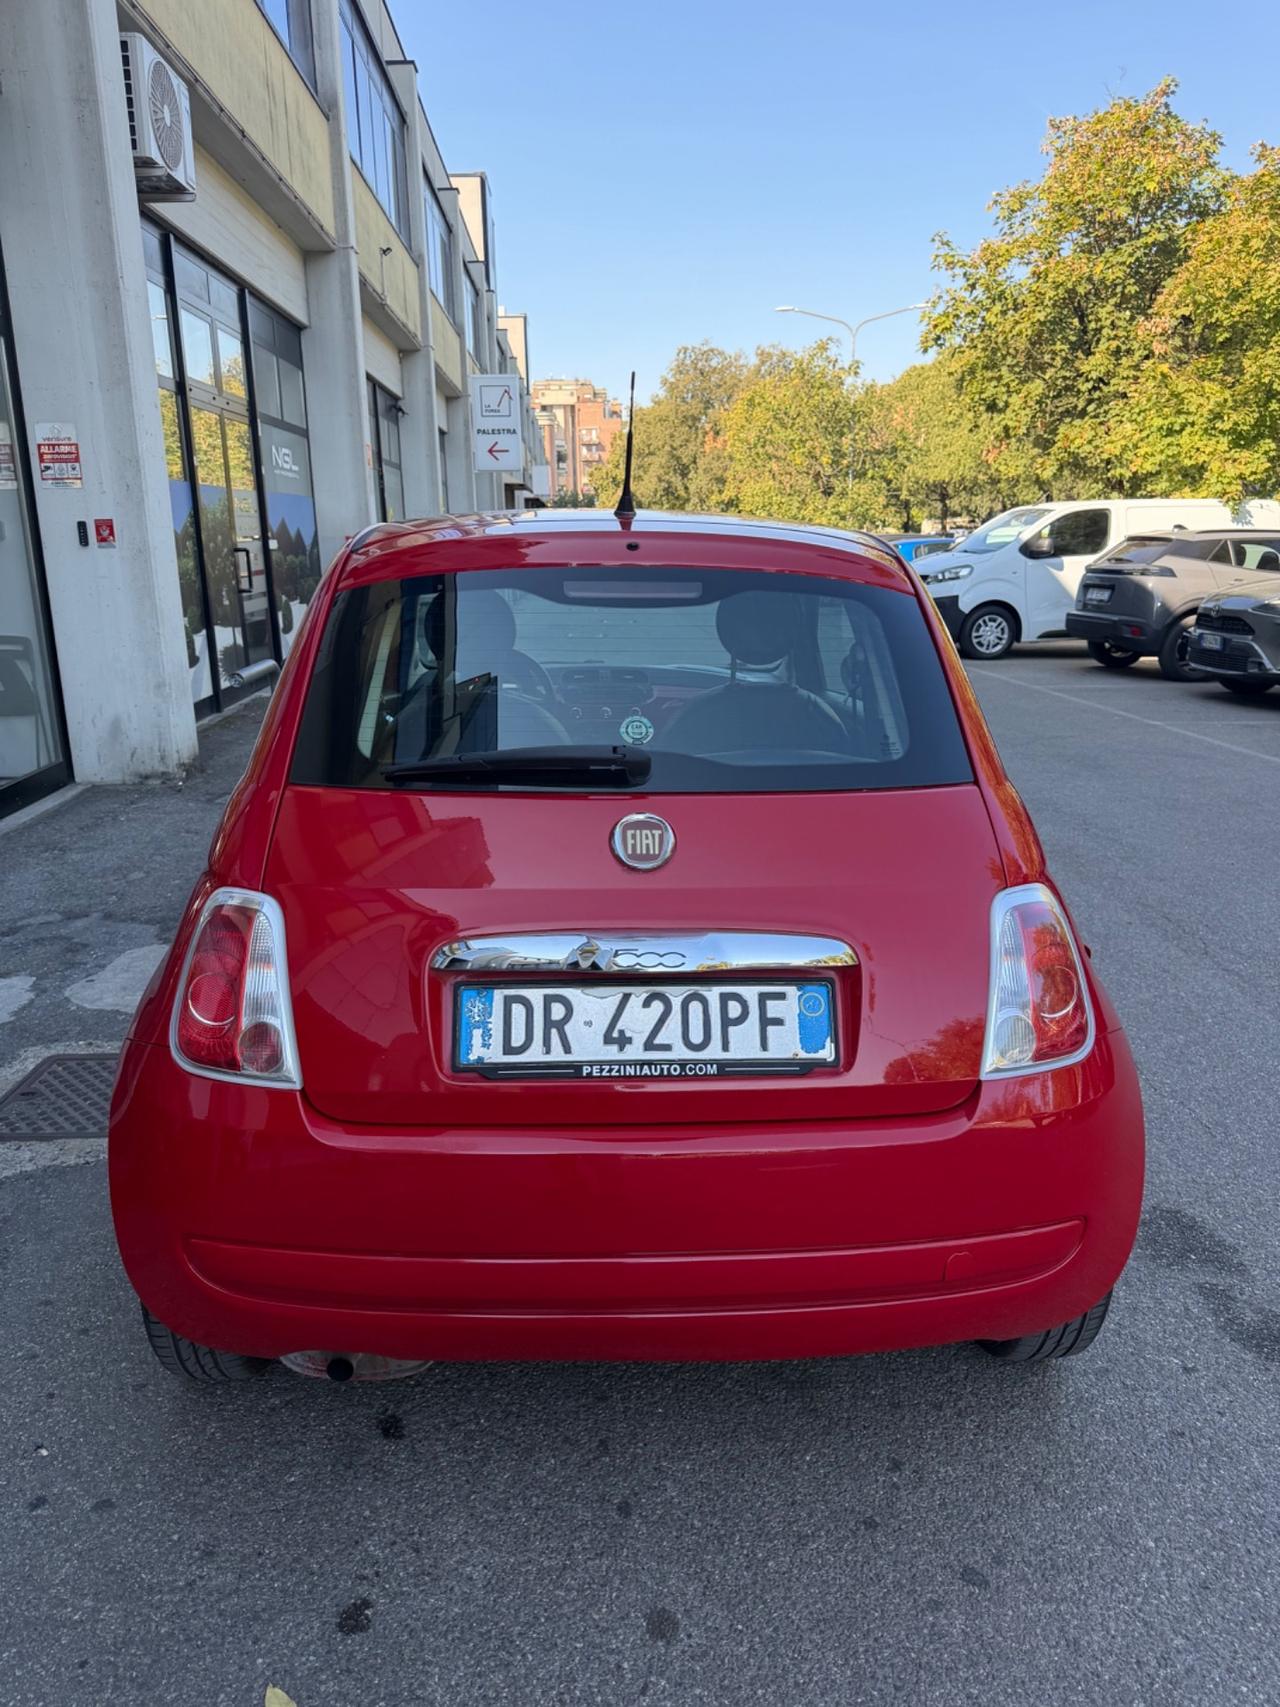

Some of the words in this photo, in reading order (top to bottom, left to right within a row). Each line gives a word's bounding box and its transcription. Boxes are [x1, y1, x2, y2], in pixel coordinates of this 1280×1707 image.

[40, 444, 78, 453] ALLARME
[626, 829, 662, 855] FIAT
[612, 948, 687, 968] 500
[582, 1063, 718, 1077] PEZZINIAUTO.COM
